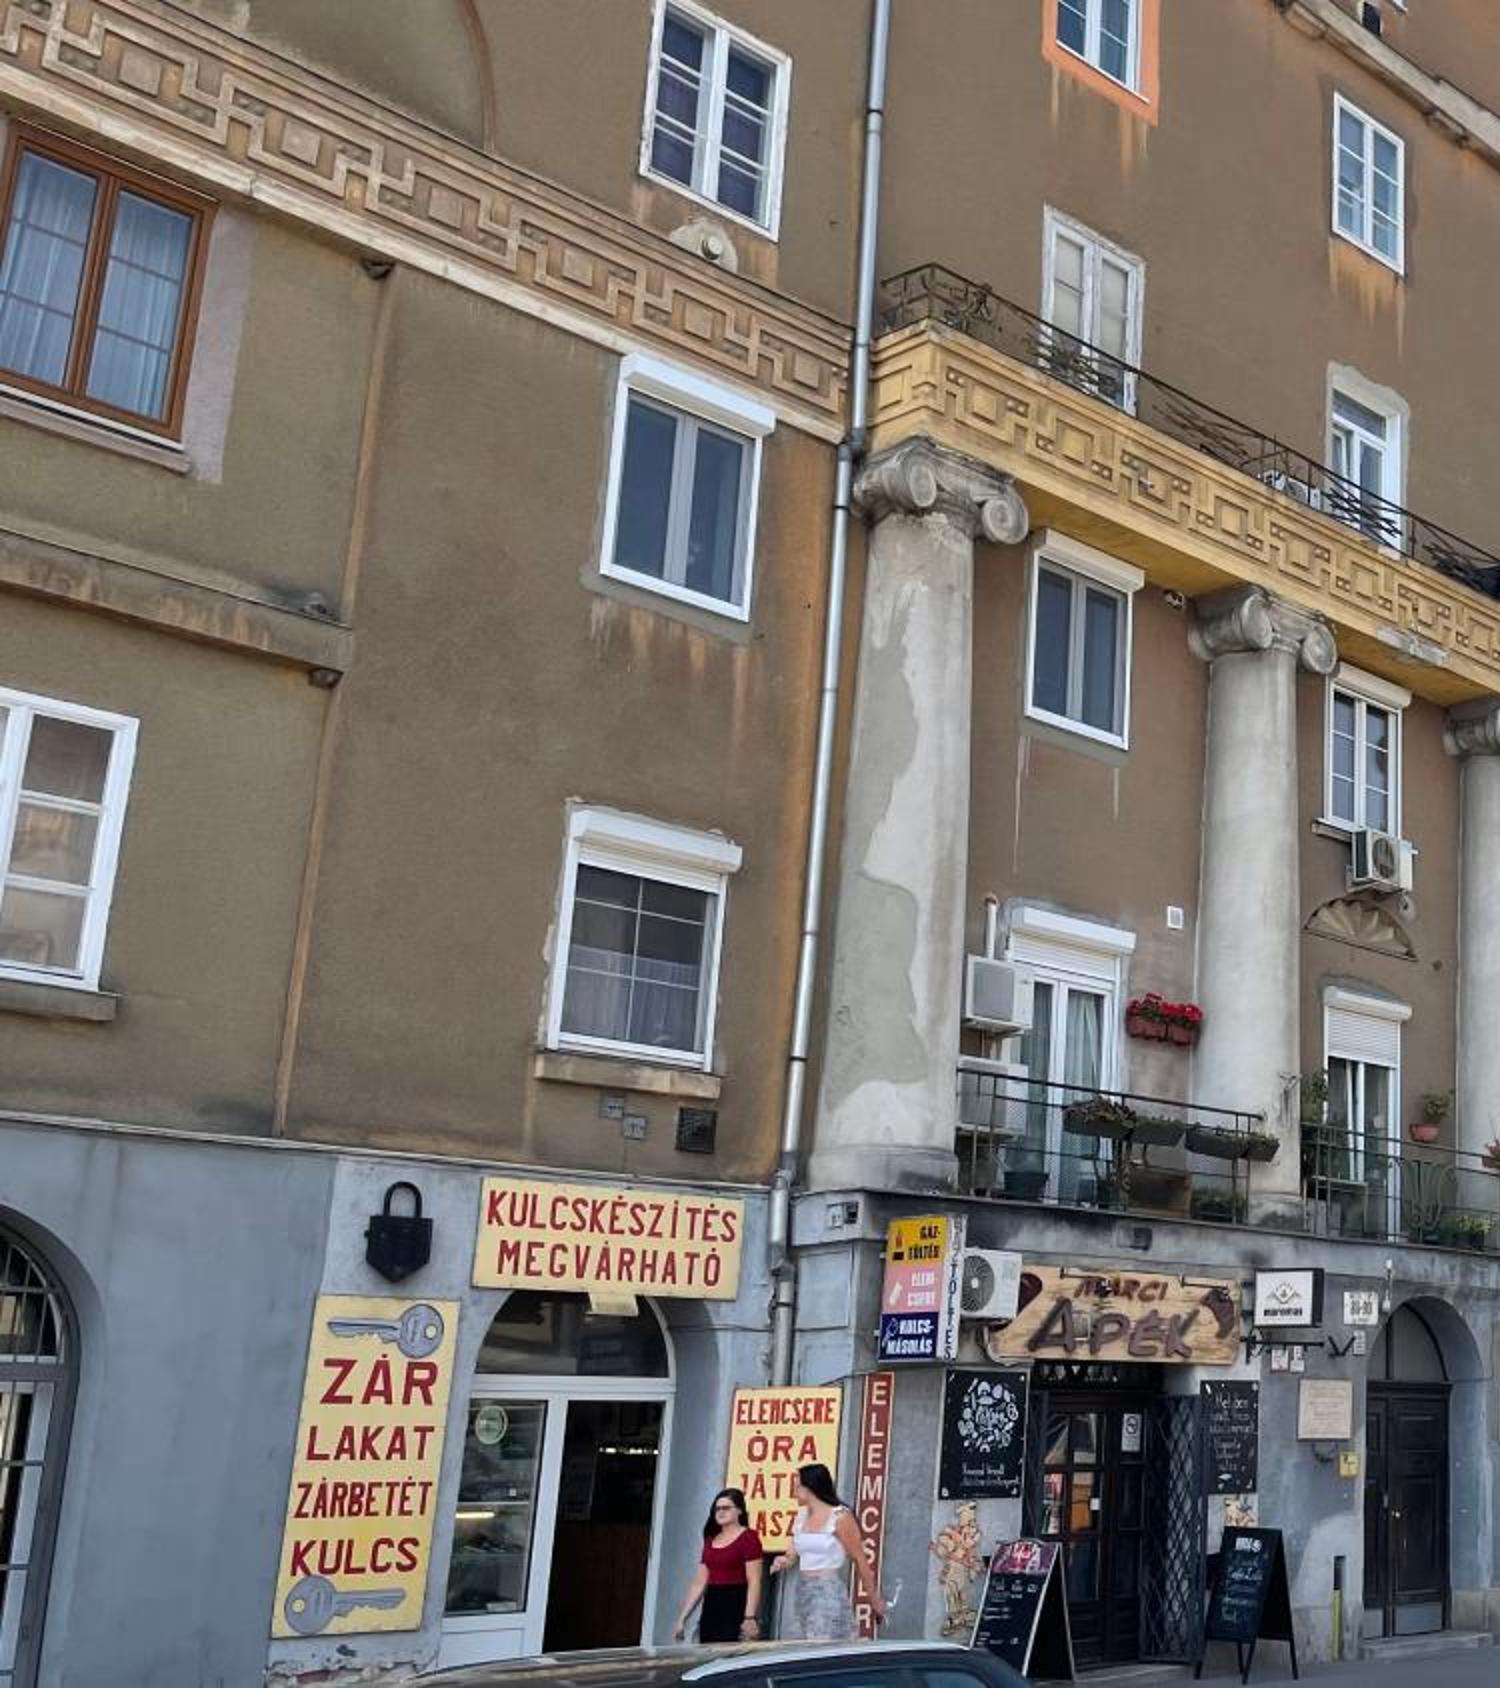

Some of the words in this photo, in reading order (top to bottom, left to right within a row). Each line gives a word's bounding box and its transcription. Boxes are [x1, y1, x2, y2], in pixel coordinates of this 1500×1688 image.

[487, 1189, 737, 1243] KULCSKÉSZÍTÉS
[497, 1240, 721, 1287] MEGVÁRHATÓ
[319, 1353, 438, 1406] ZÁR
[735, 1398, 837, 1426] ELEMCSERE
[306, 1425, 435, 1461] LAKAT
[747, 1430, 818, 1463] ÓRA
[294, 1475, 433, 1519] ZÁRBETÉT
[290, 1537, 420, 1576] KULCS
